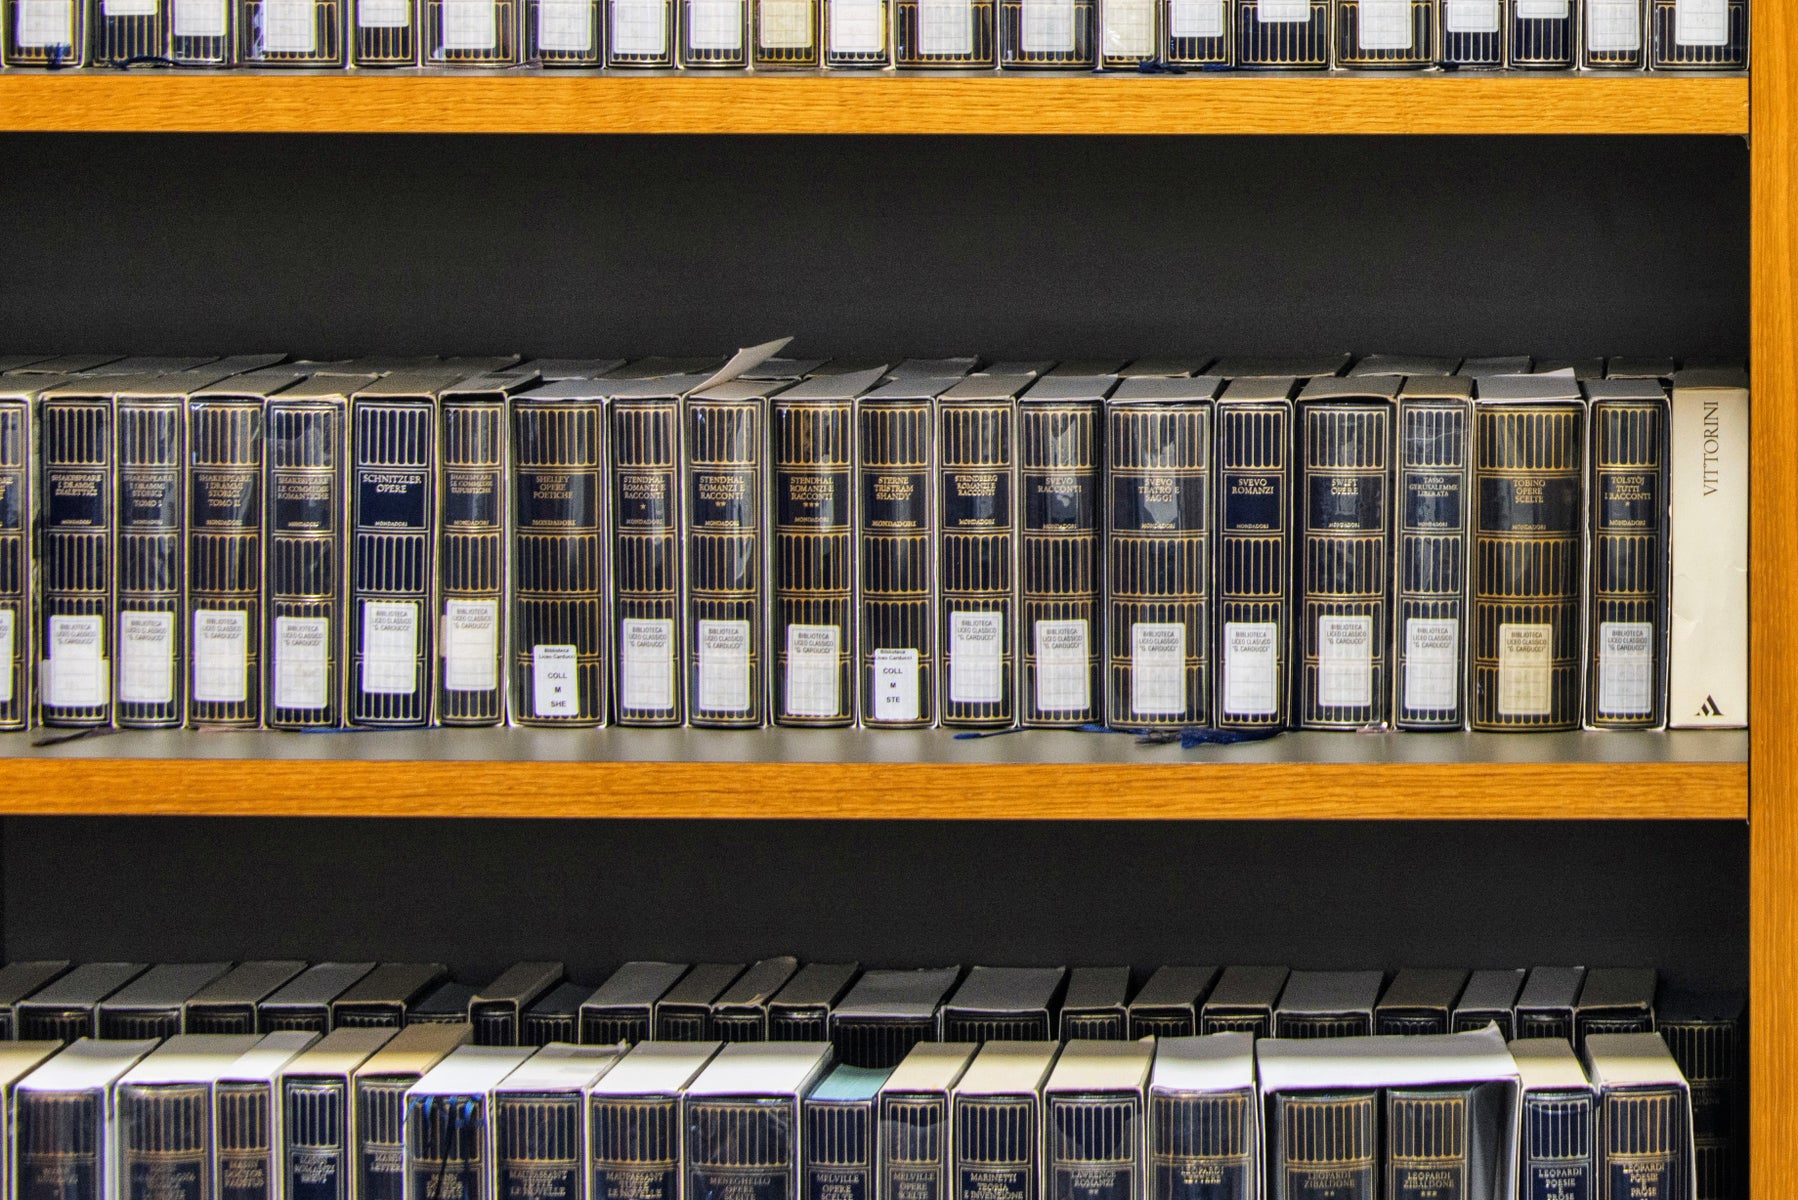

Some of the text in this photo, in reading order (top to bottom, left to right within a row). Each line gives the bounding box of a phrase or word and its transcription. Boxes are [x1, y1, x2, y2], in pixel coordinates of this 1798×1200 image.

[1702, 400, 1720, 497] VITTORINI
[364, 474, 422, 484] SCHNITZLER
[878, 476, 909, 484] STERNE
[1238, 478, 1267, 486] SVEVO
[377, 484, 408, 494] OPERE
[874, 484, 914, 493] TRISTRAM
[1232, 486, 1274, 495] ROMANZI
[876, 493, 911, 501] SHANDY
[550, 700, 566, 708] SHE
